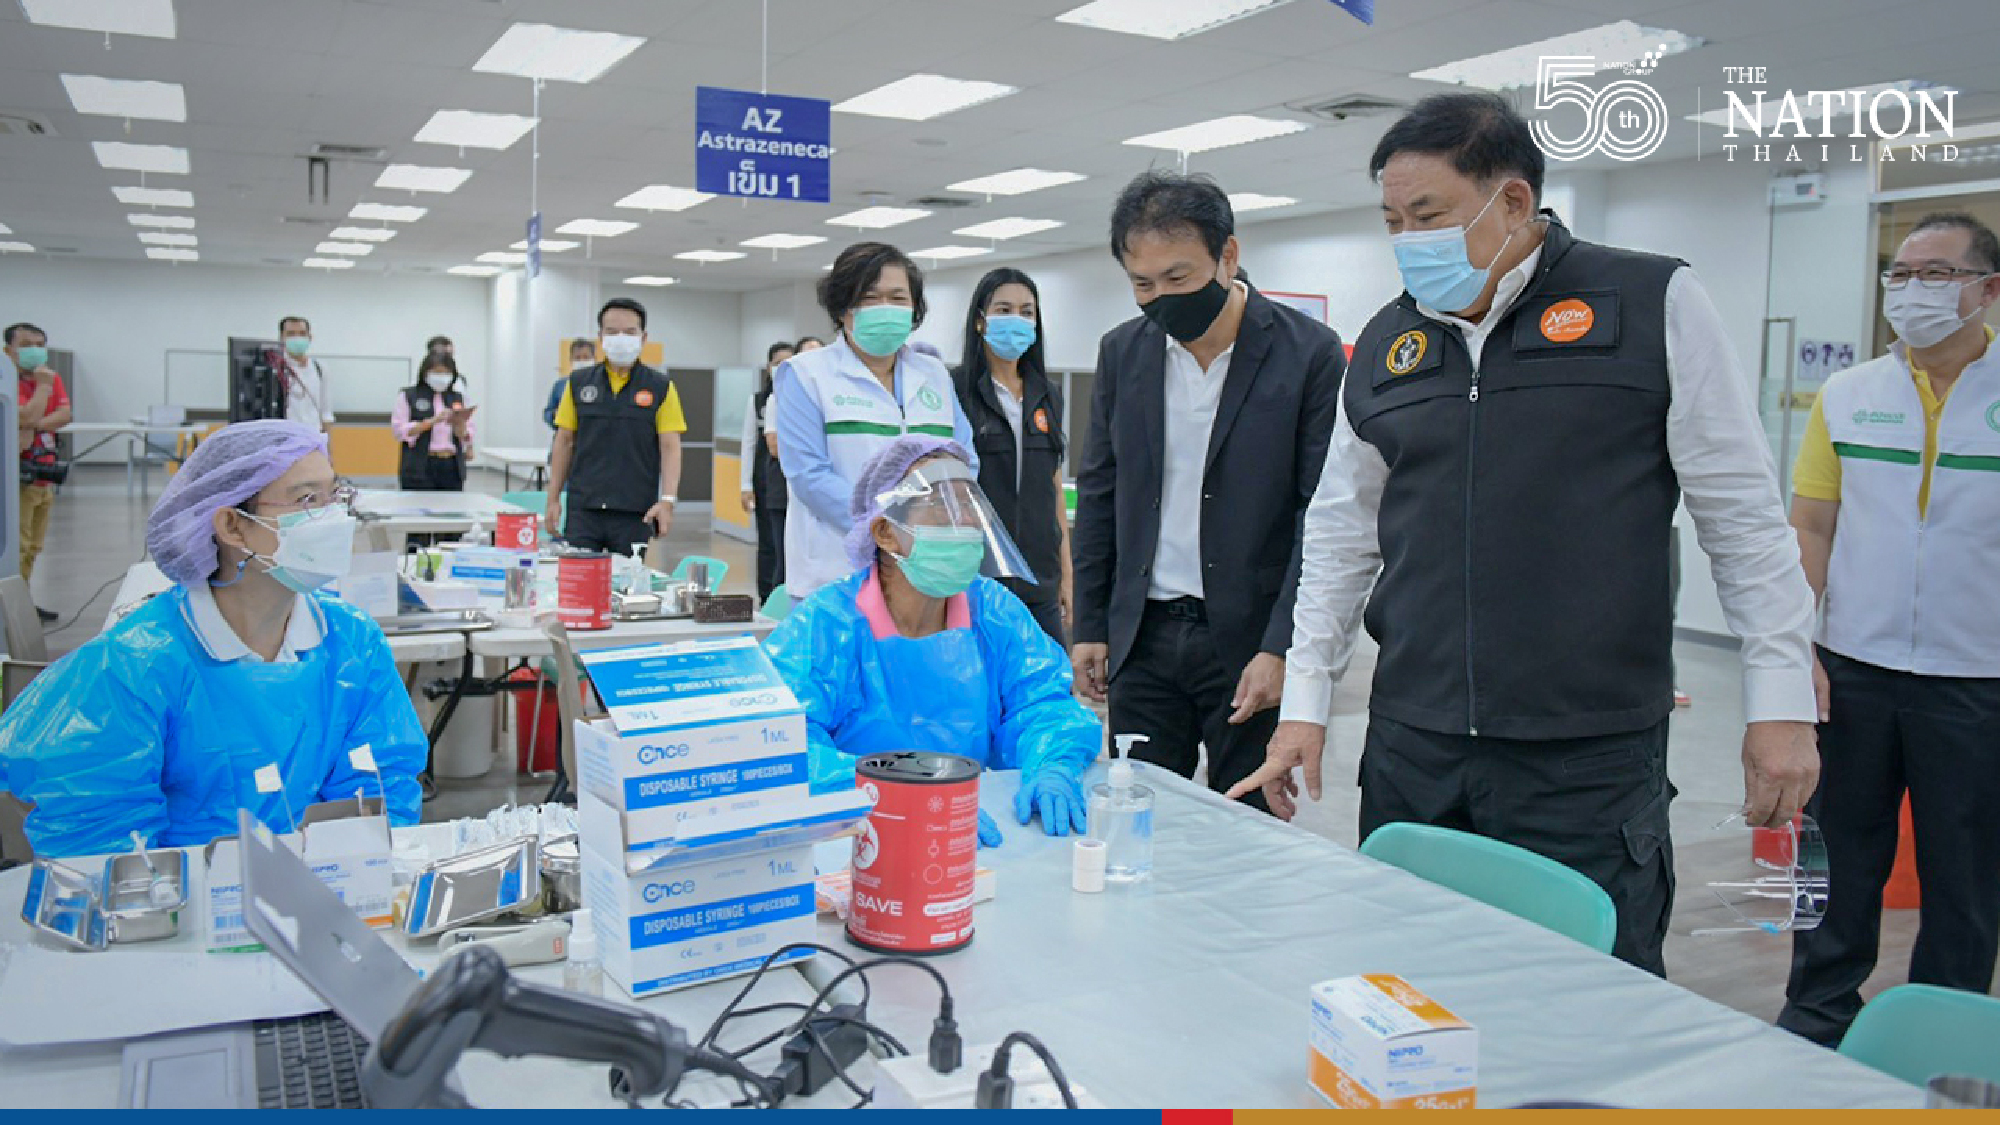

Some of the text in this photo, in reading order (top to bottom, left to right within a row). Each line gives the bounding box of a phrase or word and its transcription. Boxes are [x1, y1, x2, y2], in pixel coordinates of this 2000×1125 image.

[741, 107, 783, 134] AZ
[698, 130, 829, 159] Astrazeneca
[786, 174, 801, 198] 1
[639, 775, 698, 798] DISPOSABLE
[699, 769, 738, 788] SYRINGE
[856, 891, 903, 917] SAVE
[643, 911, 703, 935] DISPOSABLE
[705, 903, 745, 924] SYRINGE
